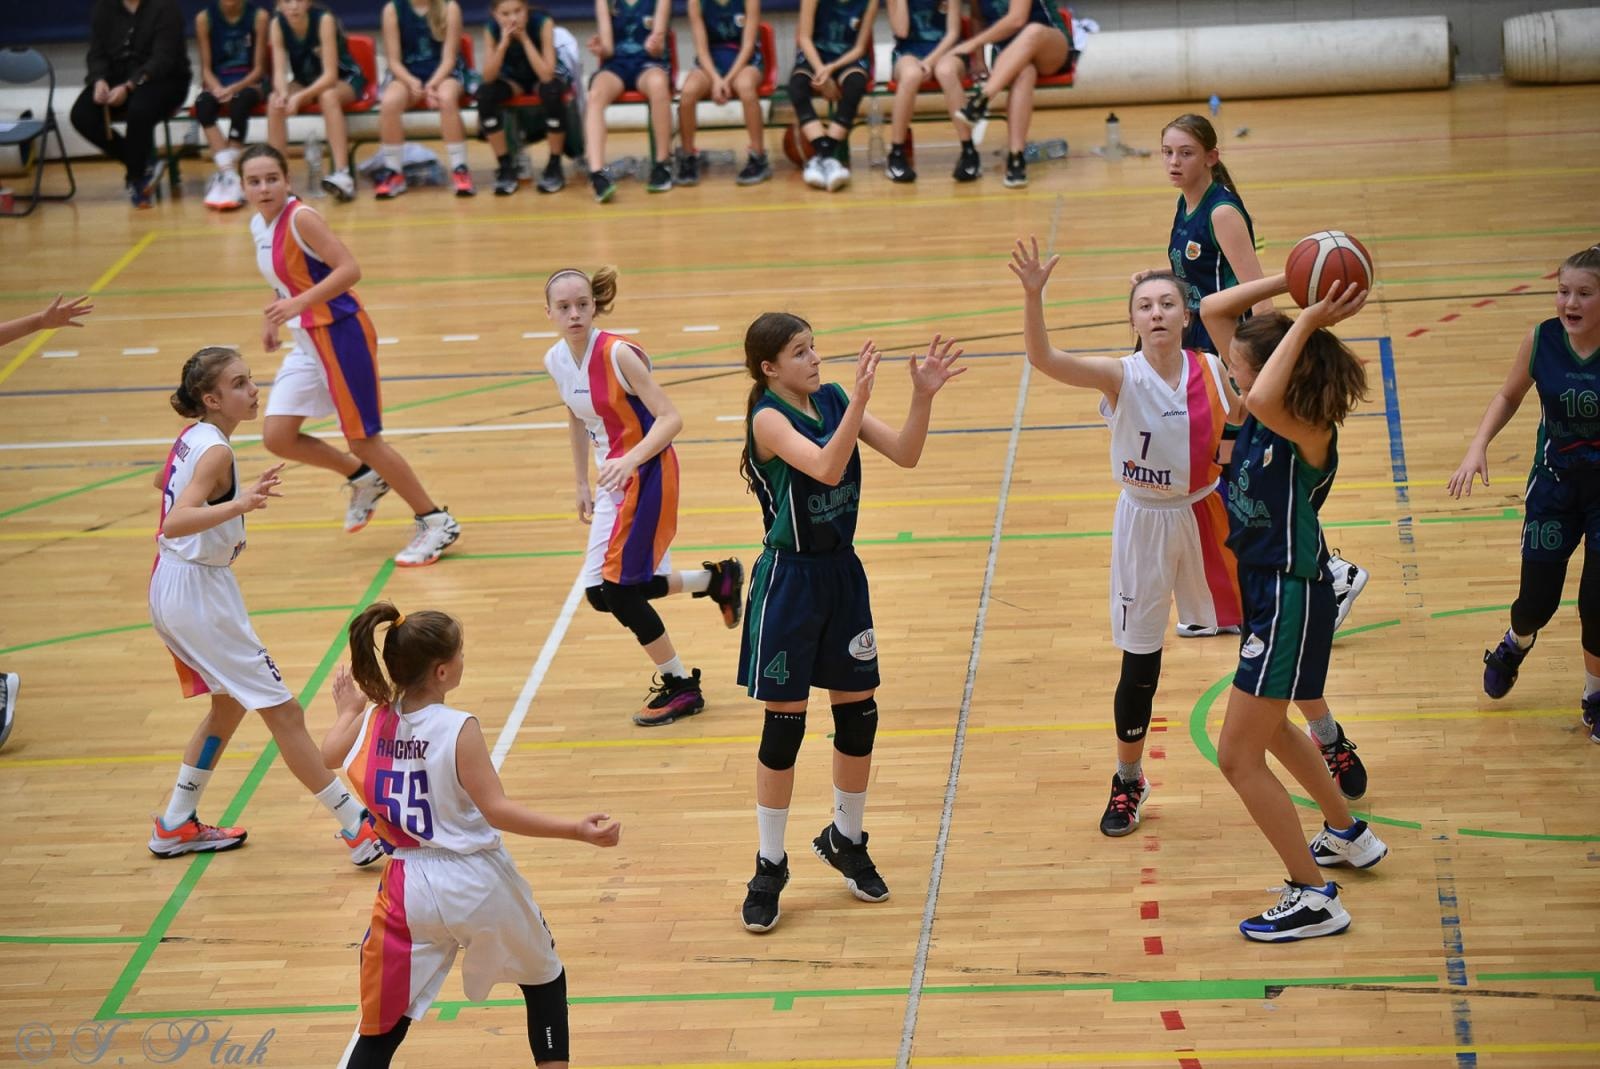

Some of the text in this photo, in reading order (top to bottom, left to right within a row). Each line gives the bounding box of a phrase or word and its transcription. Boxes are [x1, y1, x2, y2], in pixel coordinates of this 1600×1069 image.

[1559, 388, 1599, 418] 16
[1140, 431, 1152, 460] 7
[1122, 461, 1171, 486] MINI
[1527, 520, 1563, 550] 16
[763, 651, 790, 685] 4
[374, 768, 434, 841] 55
